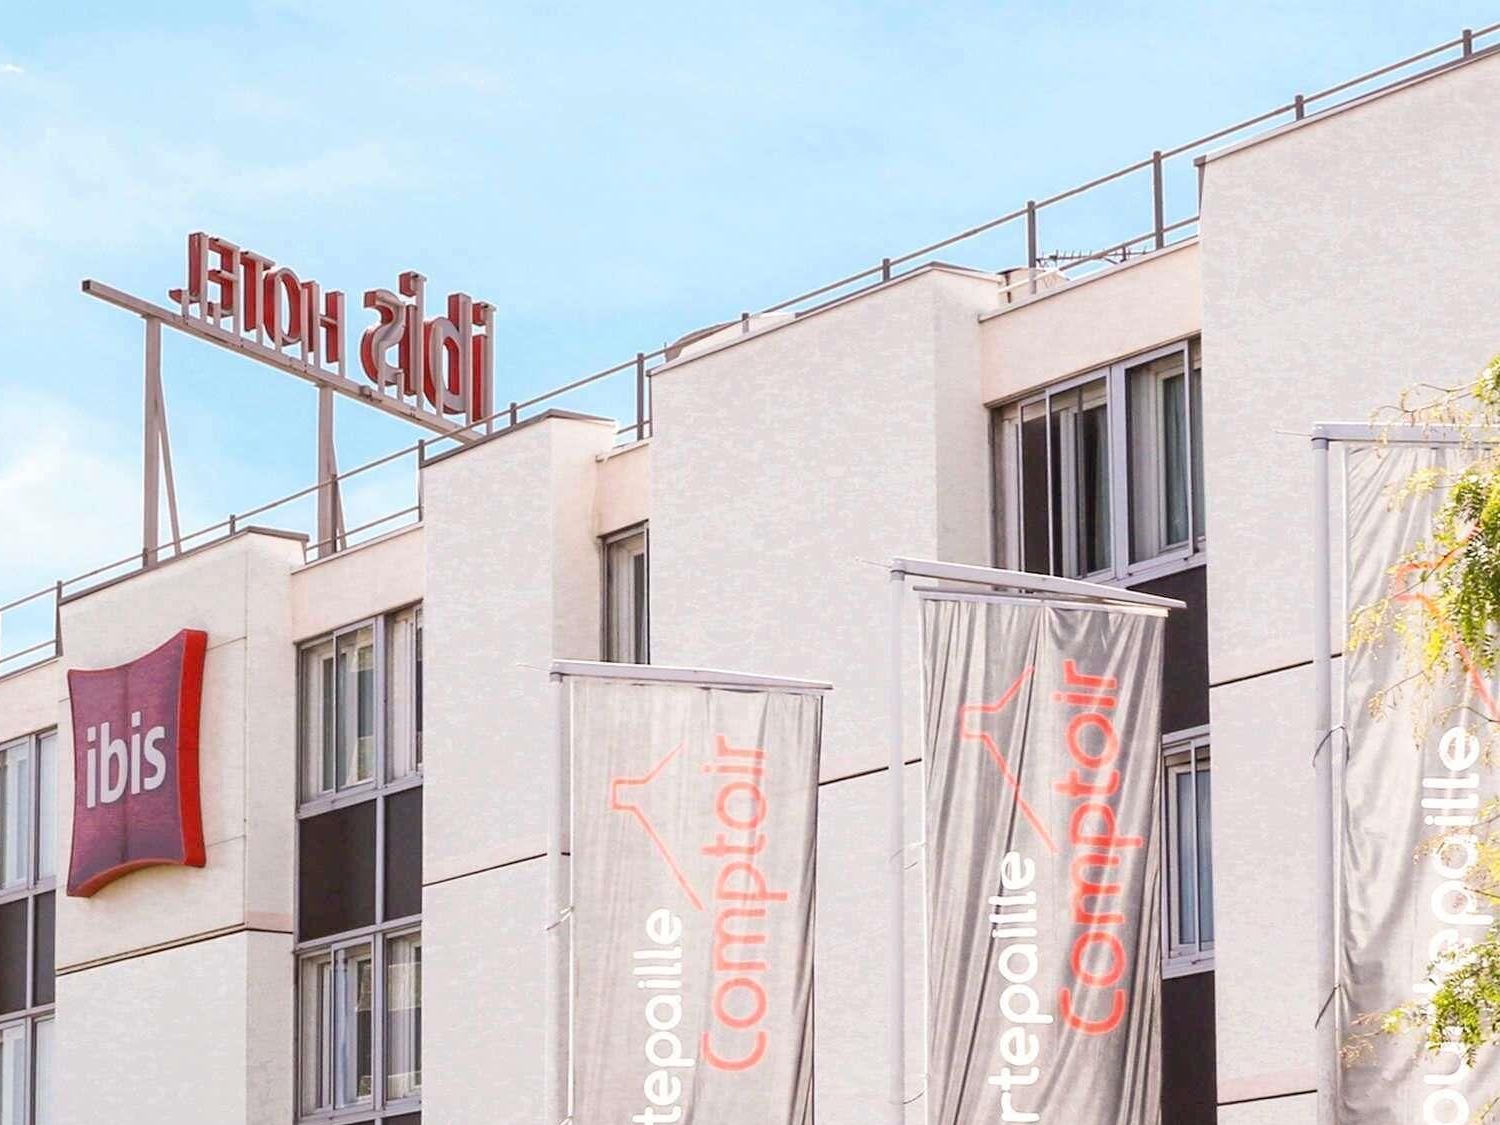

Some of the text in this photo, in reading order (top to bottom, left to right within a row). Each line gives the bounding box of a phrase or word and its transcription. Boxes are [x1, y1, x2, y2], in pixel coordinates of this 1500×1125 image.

[87, 711, 166, 808] ibis
[700, 735, 788, 1072] Comptoir
[1052, 658, 1144, 1036] Comptoir
